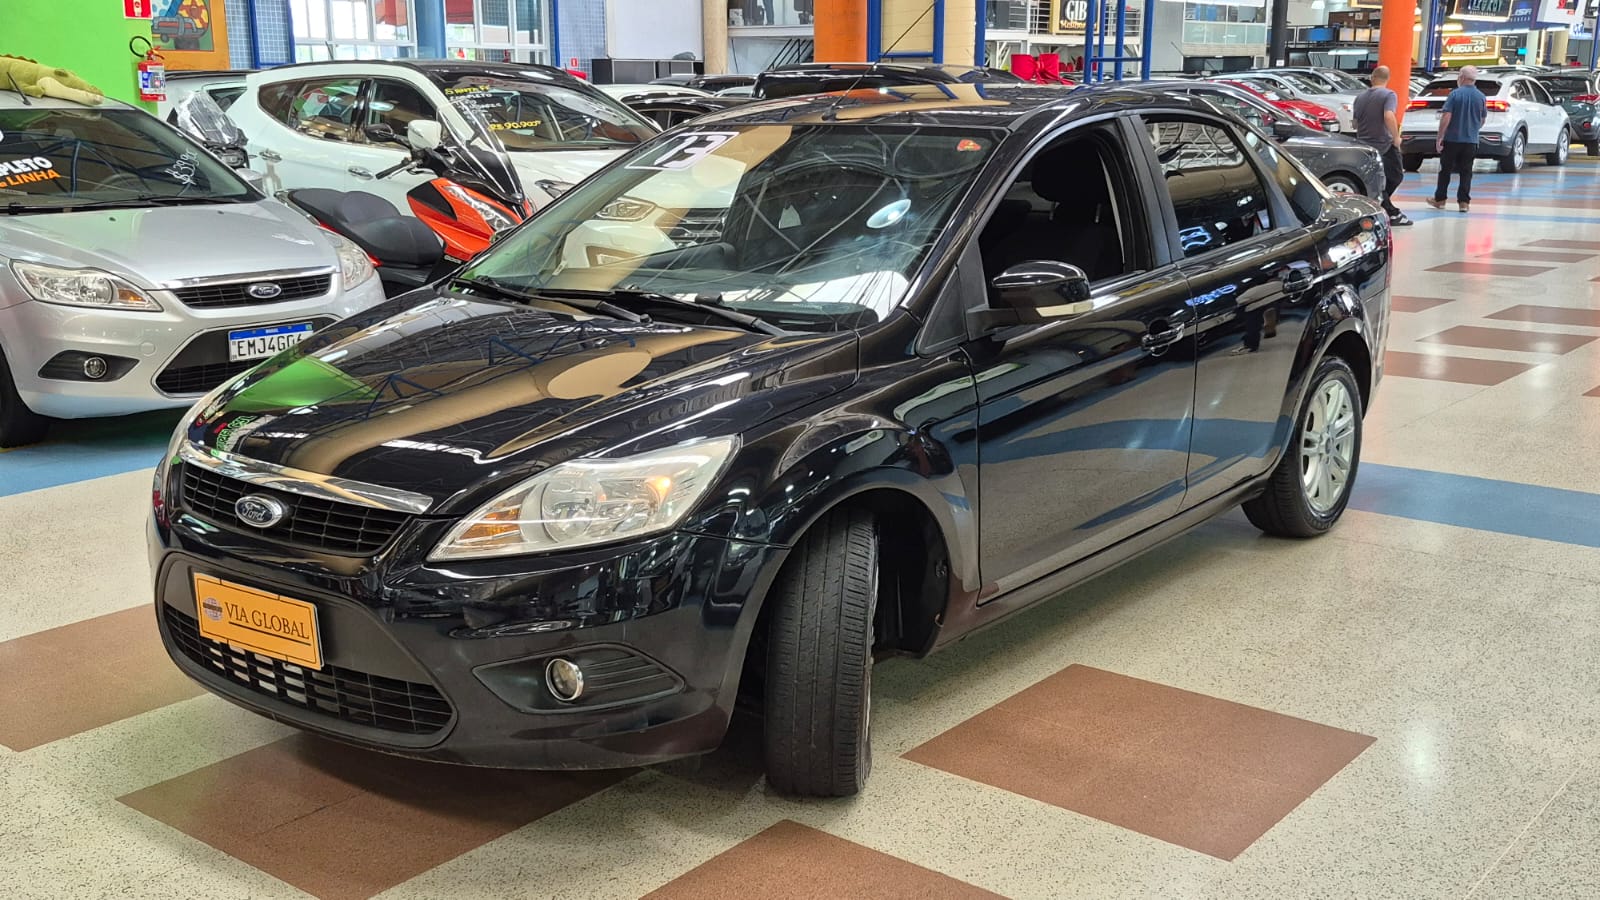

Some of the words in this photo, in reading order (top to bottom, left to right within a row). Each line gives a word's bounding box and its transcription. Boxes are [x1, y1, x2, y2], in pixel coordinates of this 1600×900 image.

[1065, 0, 1088, 21] GIB
[6, 168, 61, 186] LINHA
[225, 602, 249, 623] VIA
[251, 609, 310, 640] GLOBAL
